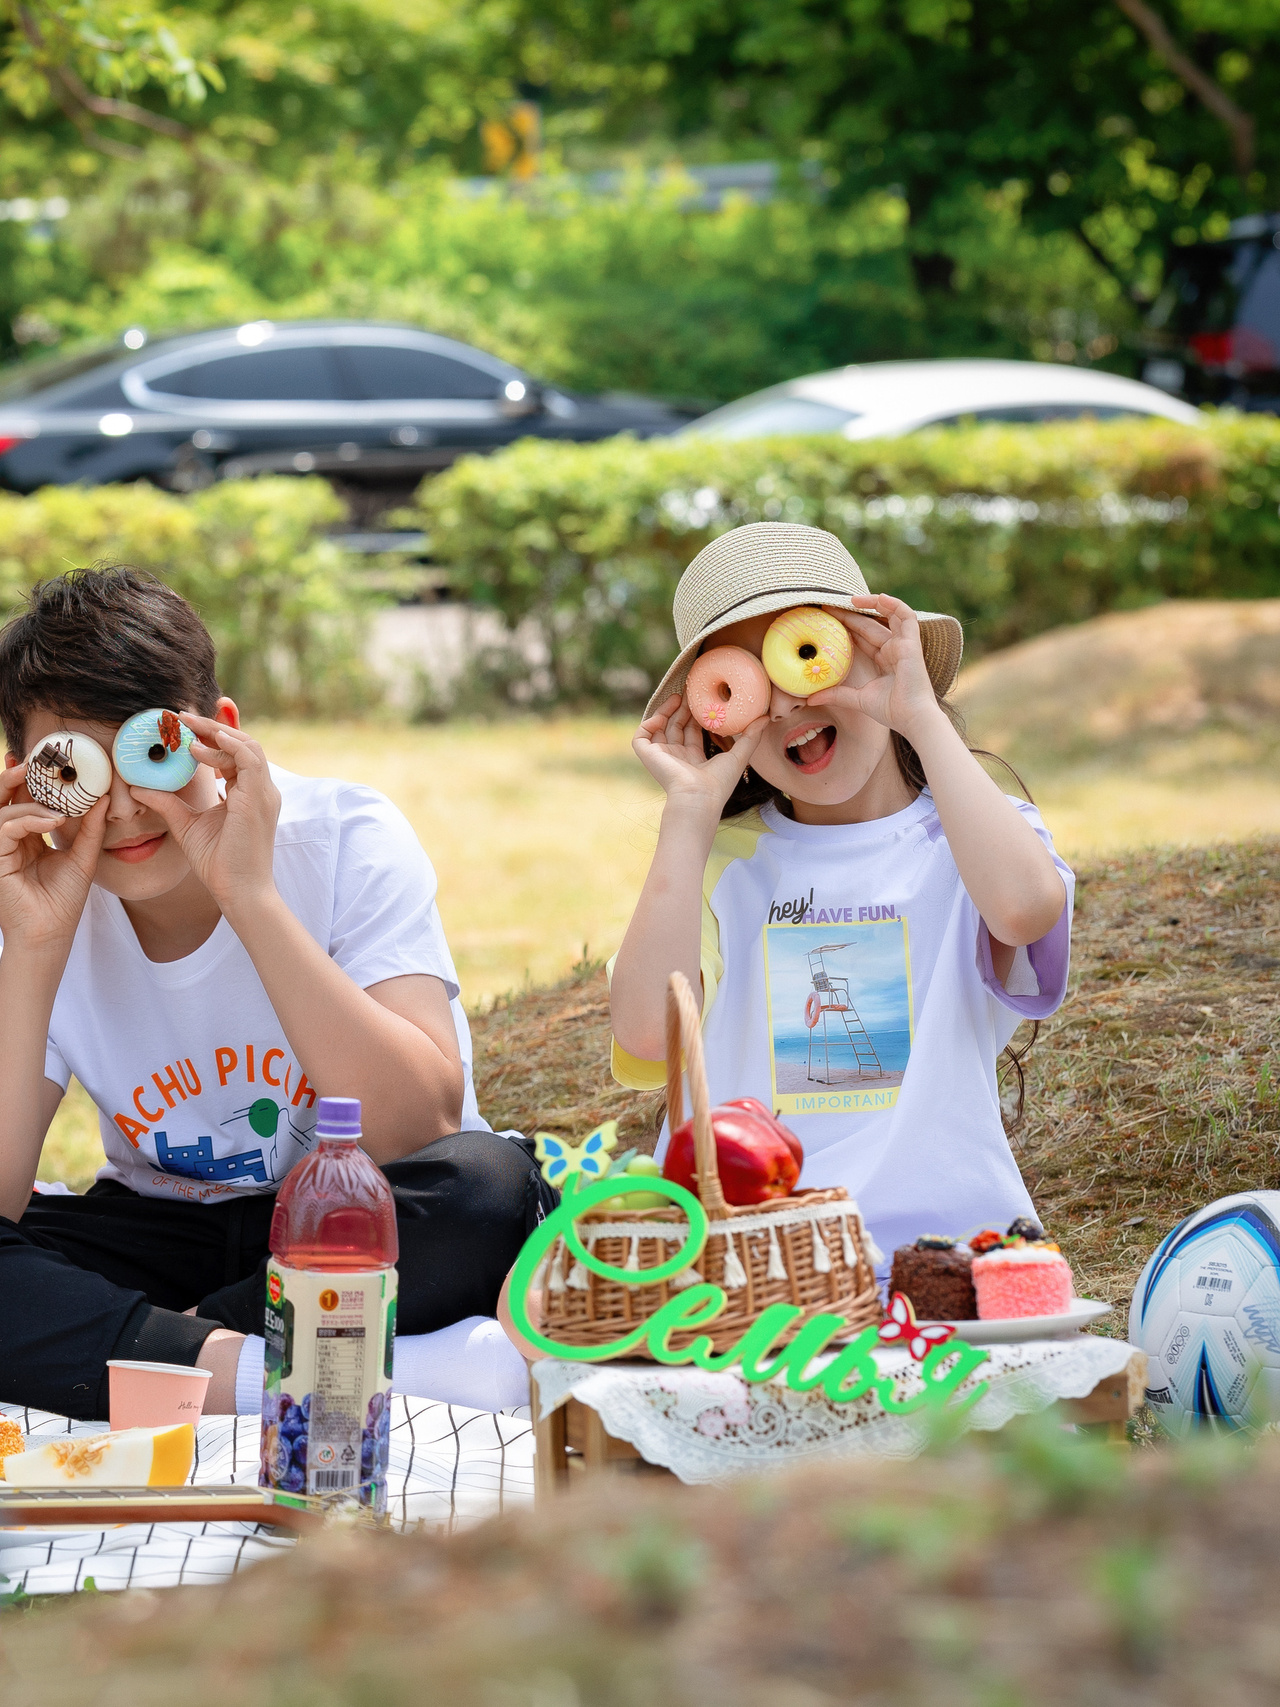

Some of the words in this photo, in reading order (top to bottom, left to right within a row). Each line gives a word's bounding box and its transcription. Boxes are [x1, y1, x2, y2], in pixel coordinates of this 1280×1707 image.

[768, 887, 814, 925] hey!
[802, 907, 853, 924] HAVE
[859, 904, 902, 923] FUN,
[795, 1091, 894, 1110] IMPORTANT
[152, 1175, 172, 1188] OF
[172, 1181, 195, 1200] THE
